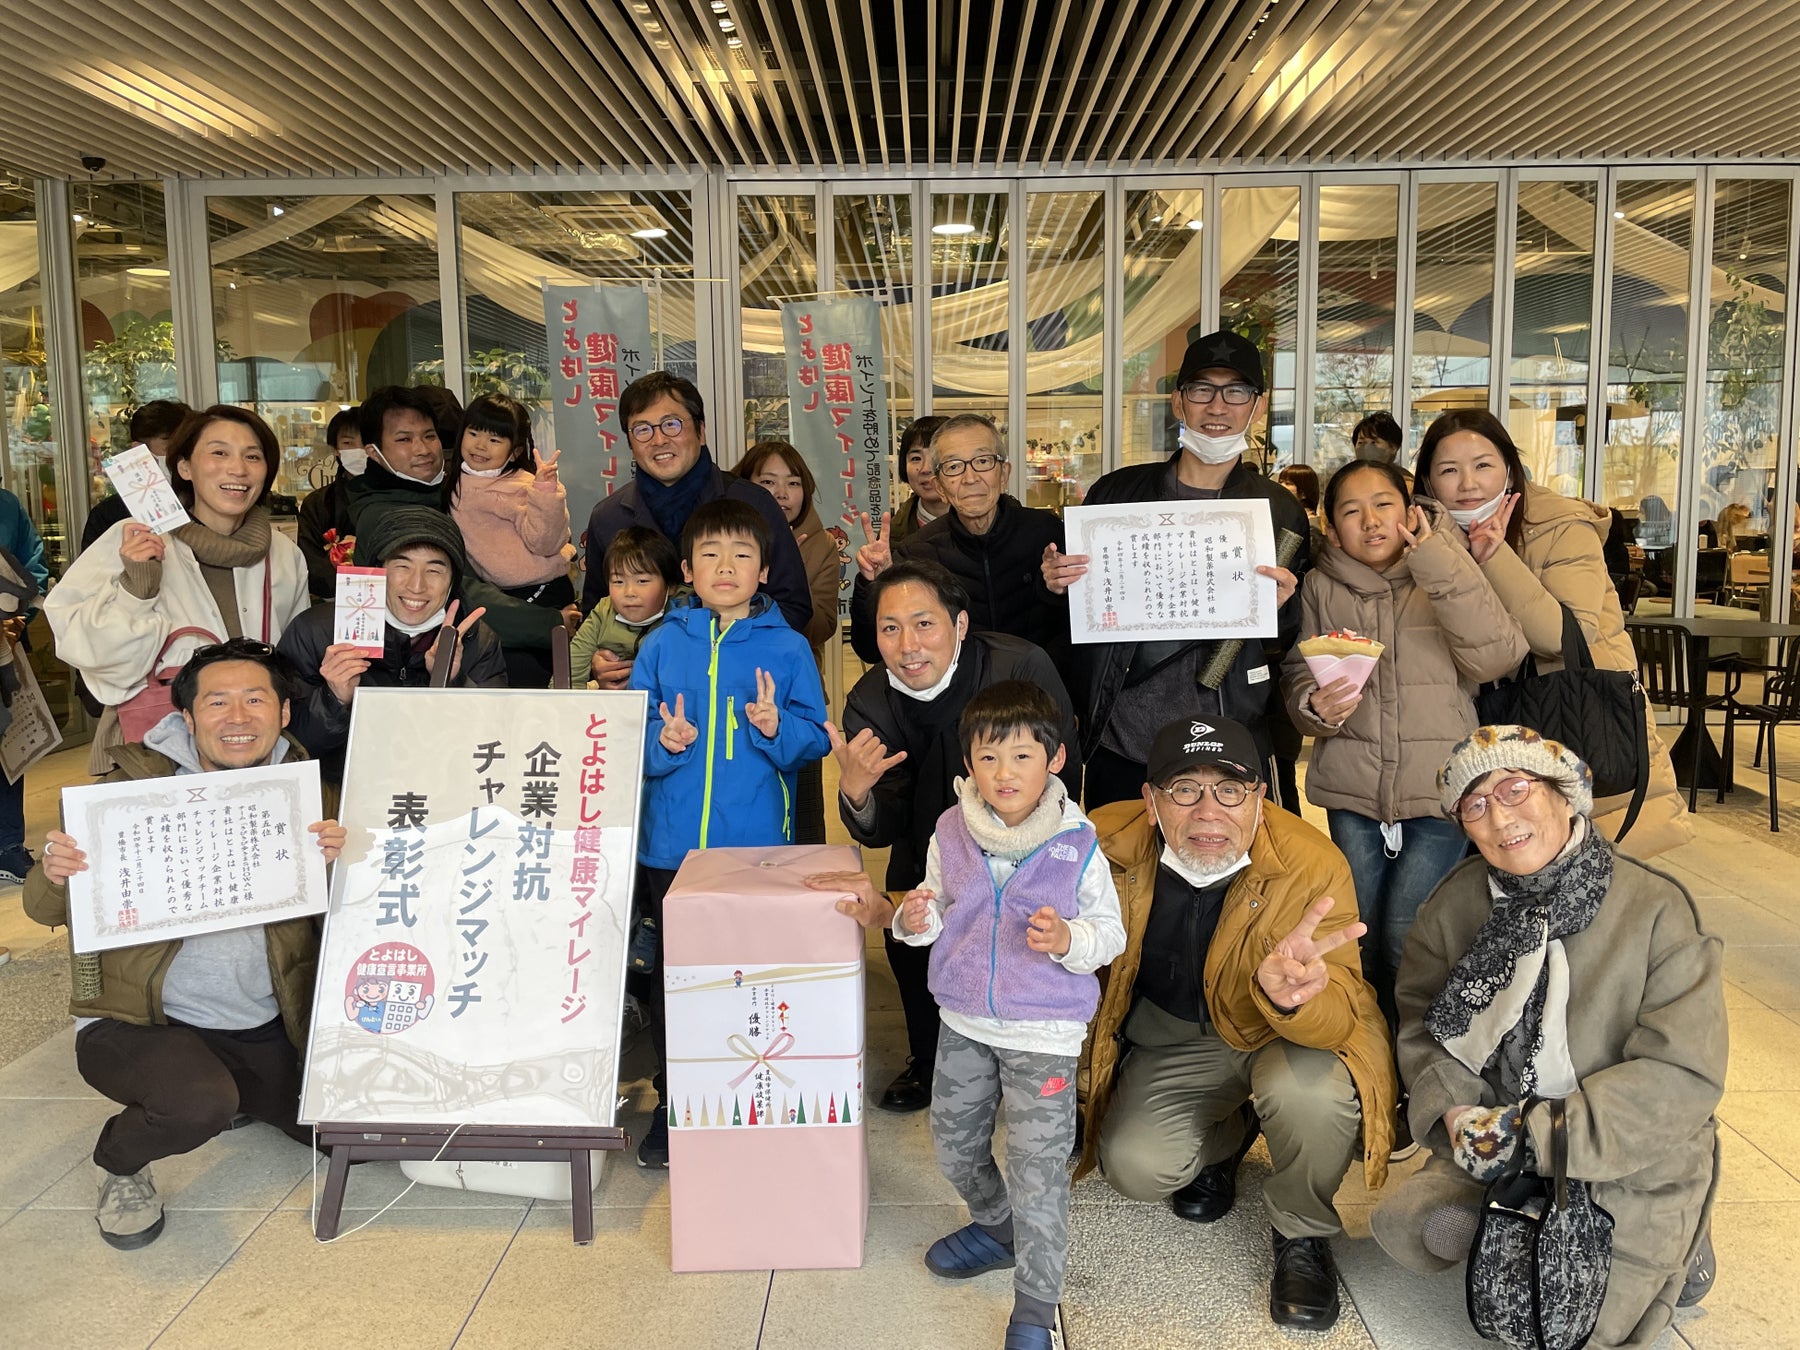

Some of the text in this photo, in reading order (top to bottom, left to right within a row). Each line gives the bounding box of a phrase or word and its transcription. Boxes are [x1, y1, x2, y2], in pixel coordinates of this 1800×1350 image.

[1141, 533, 1154, 619] 成績を収められたので
[1153, 532, 1165, 619] 部門において優秀な
[1176, 531, 1189, 618] マイレージ企業対抗
[1218, 534, 1229, 560] 優勝
[1232, 546, 1245, 582] 賞状
[1208, 606, 1216, 615] 様
[1183, 741, 1224, 750] DUNLOP
[160, 813, 178, 914] 成績を収められたので
[176, 811, 193, 912] 部門において優秀な
[192, 809, 209, 910] チャレンジマッチチーム
[207, 808, 225, 908] マイレージ企業対抗
[223, 805, 240, 905] 貴社はとよはし健康
[261, 810, 273, 837] 第五位
[274, 821, 290, 861] 賞状
[375, 791, 430, 929] 表彰式
[512, 740, 562, 902] 企業対抗
[447, 738, 507, 1021] チャレンジマッチ
[560, 713, 609, 1025] とよはし健康マイレージ
[356, 963, 427, 977] 健康宣言事業所
[369, 949, 418, 962] とよはし
[748, 1012, 761, 1038] 優勝
[1046, 1077, 1066, 1089] NIKE
